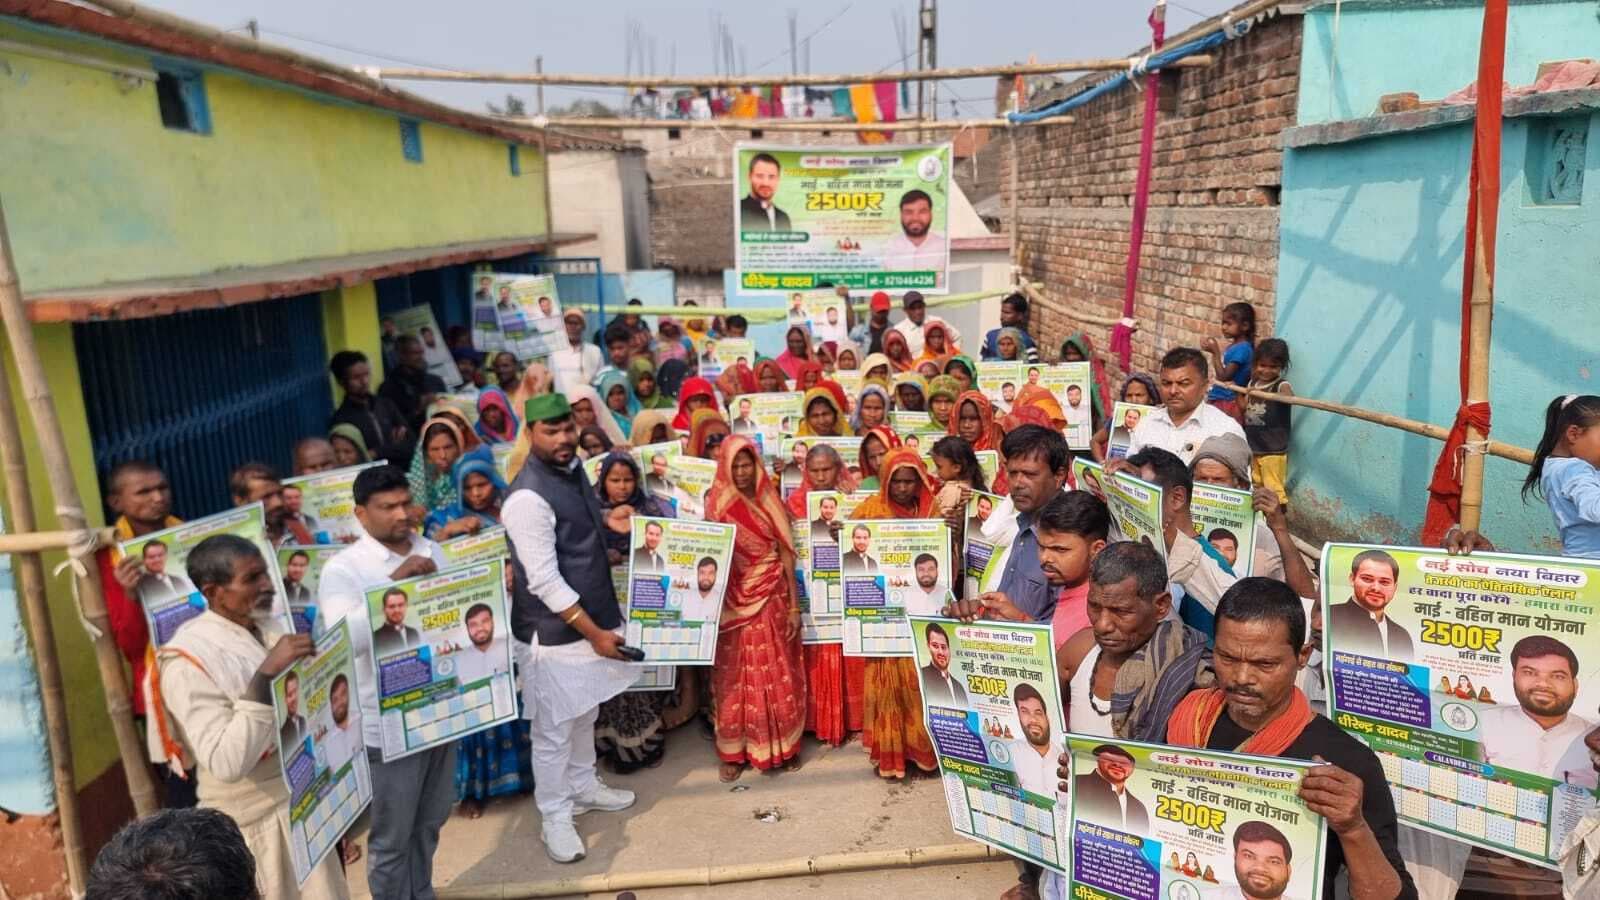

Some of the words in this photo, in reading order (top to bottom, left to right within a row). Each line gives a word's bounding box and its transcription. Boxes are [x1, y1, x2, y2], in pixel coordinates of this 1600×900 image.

[807, 192, 884, 211] 2500₹
[1425, 559, 1450, 573] नई
[1456, 562, 1489, 575] सोच
[1495, 566, 1530, 579] नया
[1536, 568, 1581, 585] बिहार
[1409, 586, 1422, 596] हर
[1426, 588, 1452, 599] वादा
[1456, 590, 1476, 605] पूरा
[1480, 592, 1510, 606] करेंगे
[1524, 598, 1560, 612] हमारा
[1564, 604, 1594, 616] वादा
[1414, 602, 1442, 618] माई
[1455, 604, 1494, 624] बहिन
[1498, 612, 1530, 628] मान
[1534, 614, 1586, 636] योजना
[1420, 618, 1502, 654] 2500₹
[1458, 650, 1476, 662] प्रति
[1480, 654, 1501, 664] माह
[962, 660, 974, 674] माई
[980, 664, 1000, 678] बहिन
[1001, 668, 1018, 678] मान
[1018, 666, 1043, 682] योजना
[967, 675, 1008, 698] 2500₹
[1338, 714, 1374, 734] धीरेन्द्र
[1376, 724, 1408, 740] यादव
[1158, 754, 1179, 764] नई
[1184, 757, 1215, 767] सोच
[1220, 763, 1249, 772] नया
[1255, 766, 1296, 779] बिहार
[1151, 778, 1176, 794] माई
[1186, 785, 1220, 804] बहिन
[1224, 794, 1251, 813] मान
[1255, 800, 1300, 826] योजना
[1156, 794, 1227, 834] 2500₹
